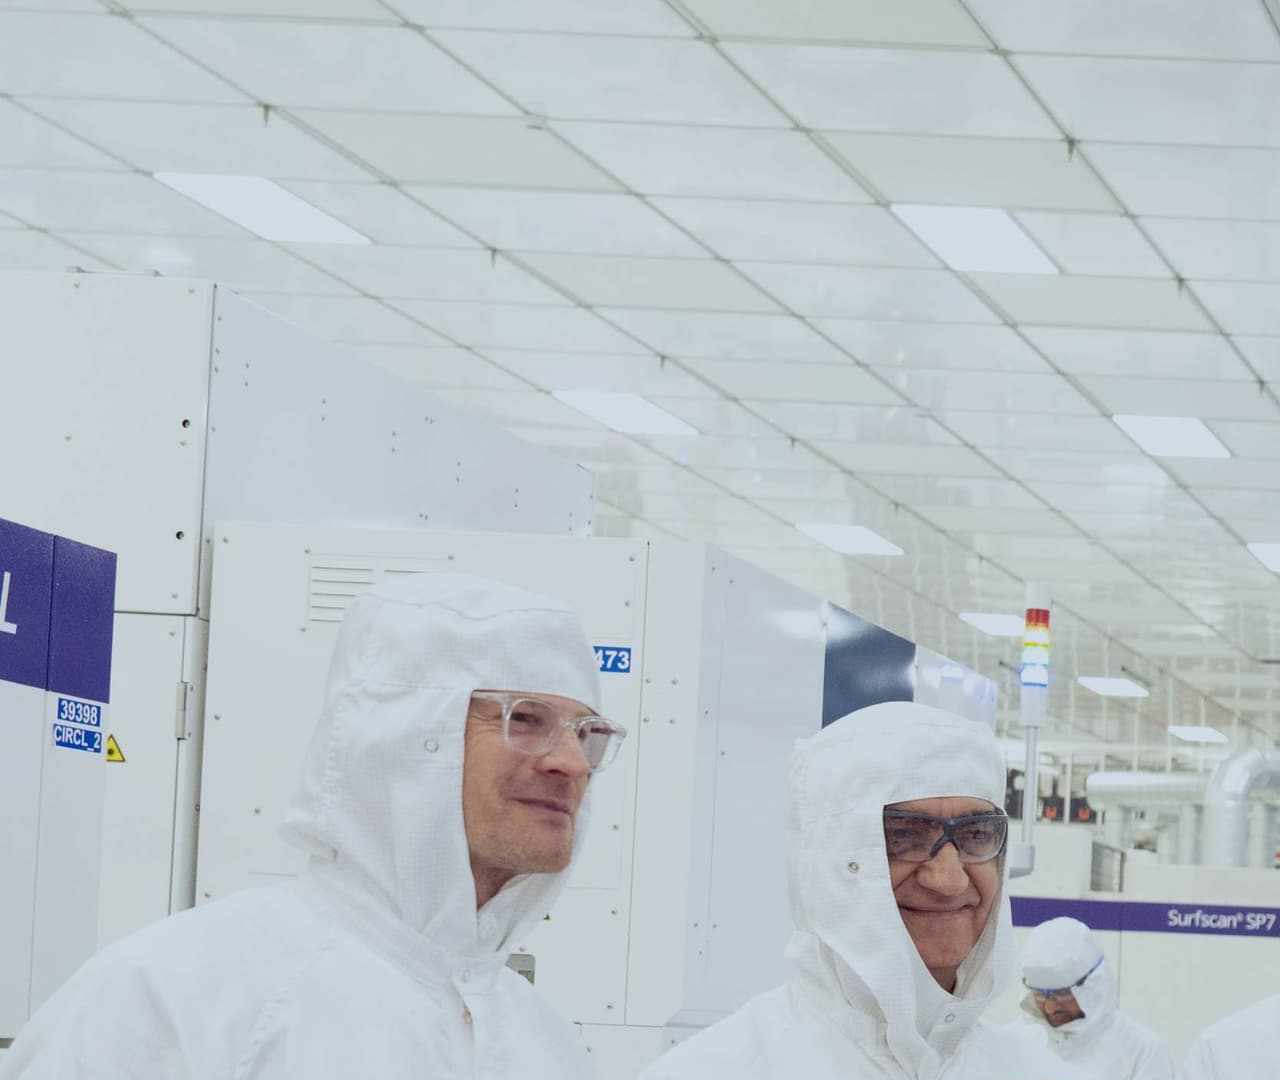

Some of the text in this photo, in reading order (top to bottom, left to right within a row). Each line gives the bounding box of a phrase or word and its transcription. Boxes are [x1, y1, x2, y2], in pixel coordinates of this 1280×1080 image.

[60, 700, 98, 725] 39398
[54, 725, 101, 751] CIRCL_2
[1245, 912, 1276, 930] SP7
